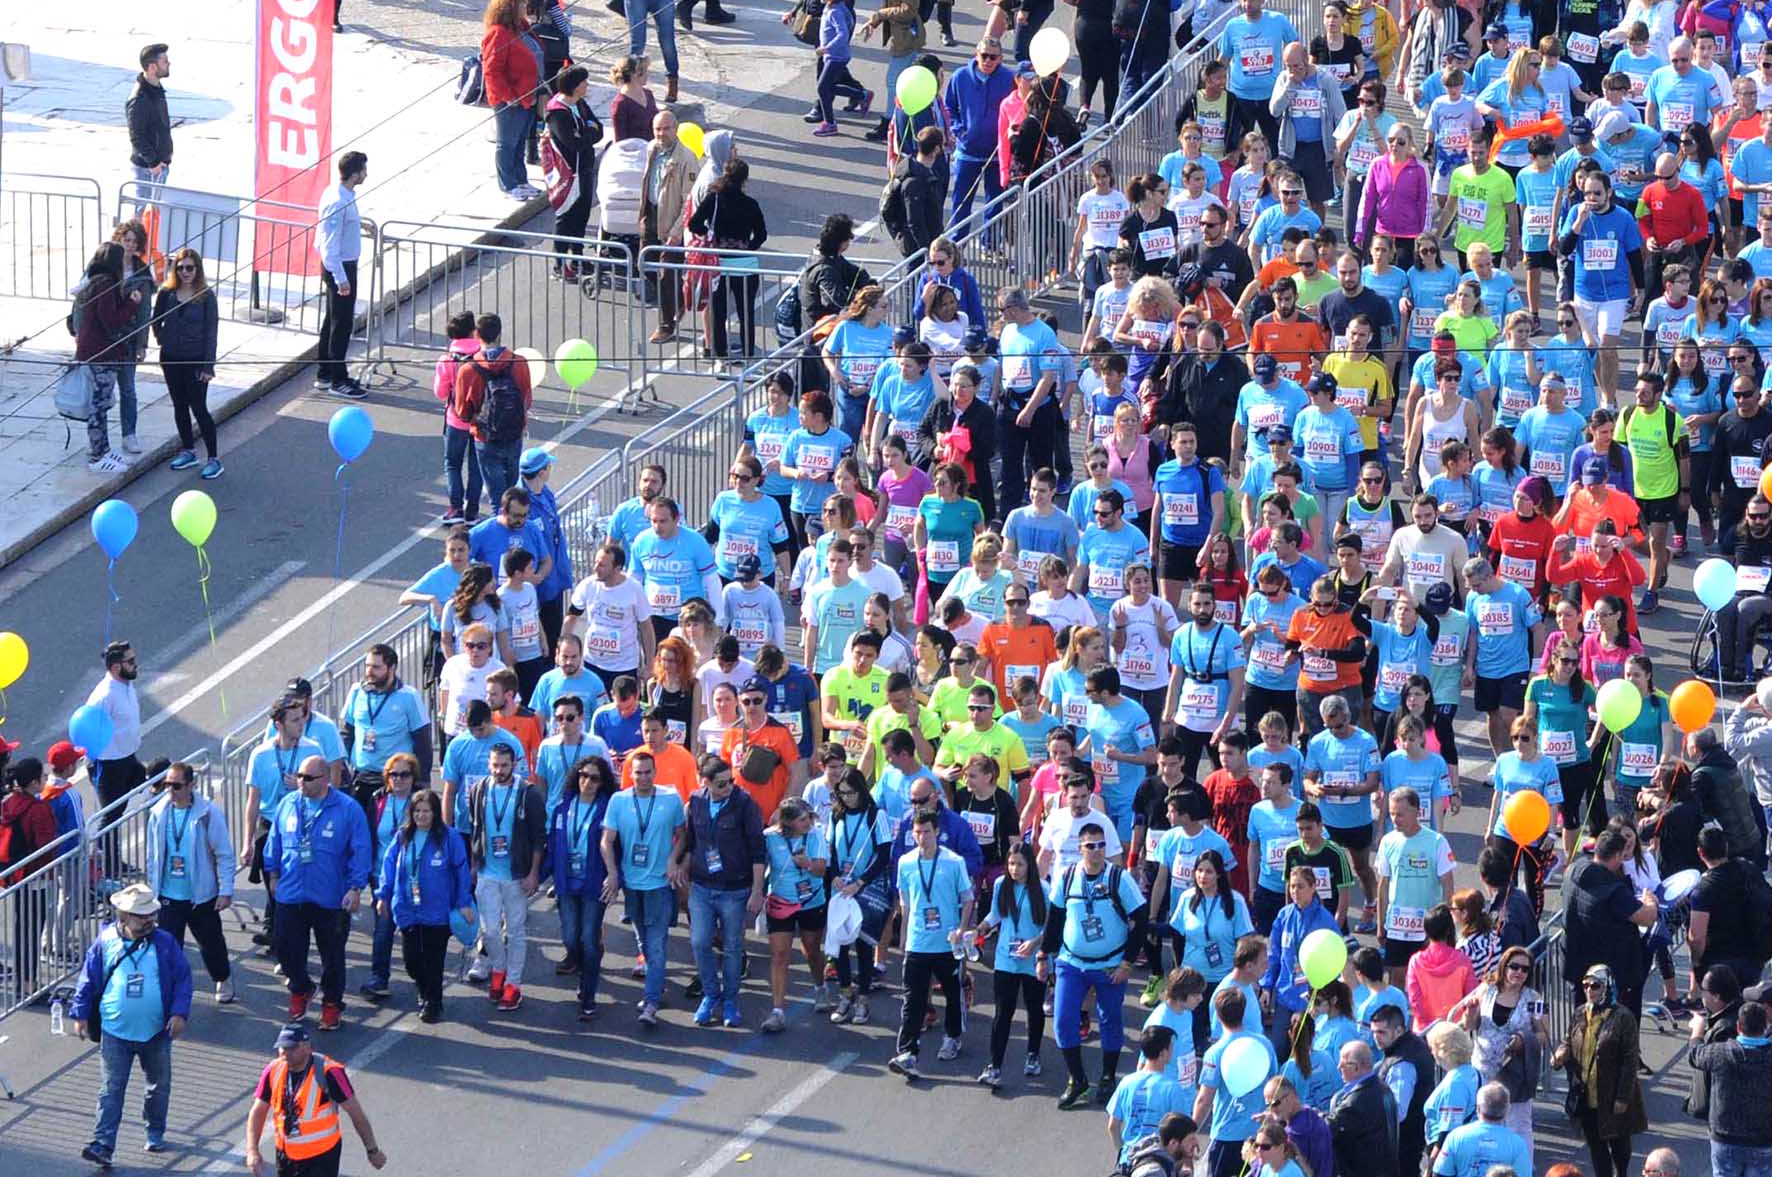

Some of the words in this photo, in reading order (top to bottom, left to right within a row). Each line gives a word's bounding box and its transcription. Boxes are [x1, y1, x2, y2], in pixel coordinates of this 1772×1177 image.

[1145, 238, 1169, 249] 31392
[1588, 249, 1613, 258] 31003
[1307, 442, 1335, 451] 30902
[802, 455, 828, 465] 32195
[1533, 461, 1561, 471] 30863
[1168, 504, 1193, 513] 30241
[1411, 563, 1441, 573] 30402
[1481, 613, 1509, 622] 30385
[736, 630, 764, 639] 30895
[1125, 662, 1151, 671] 31760
[1393, 916, 1423, 927] 30362
